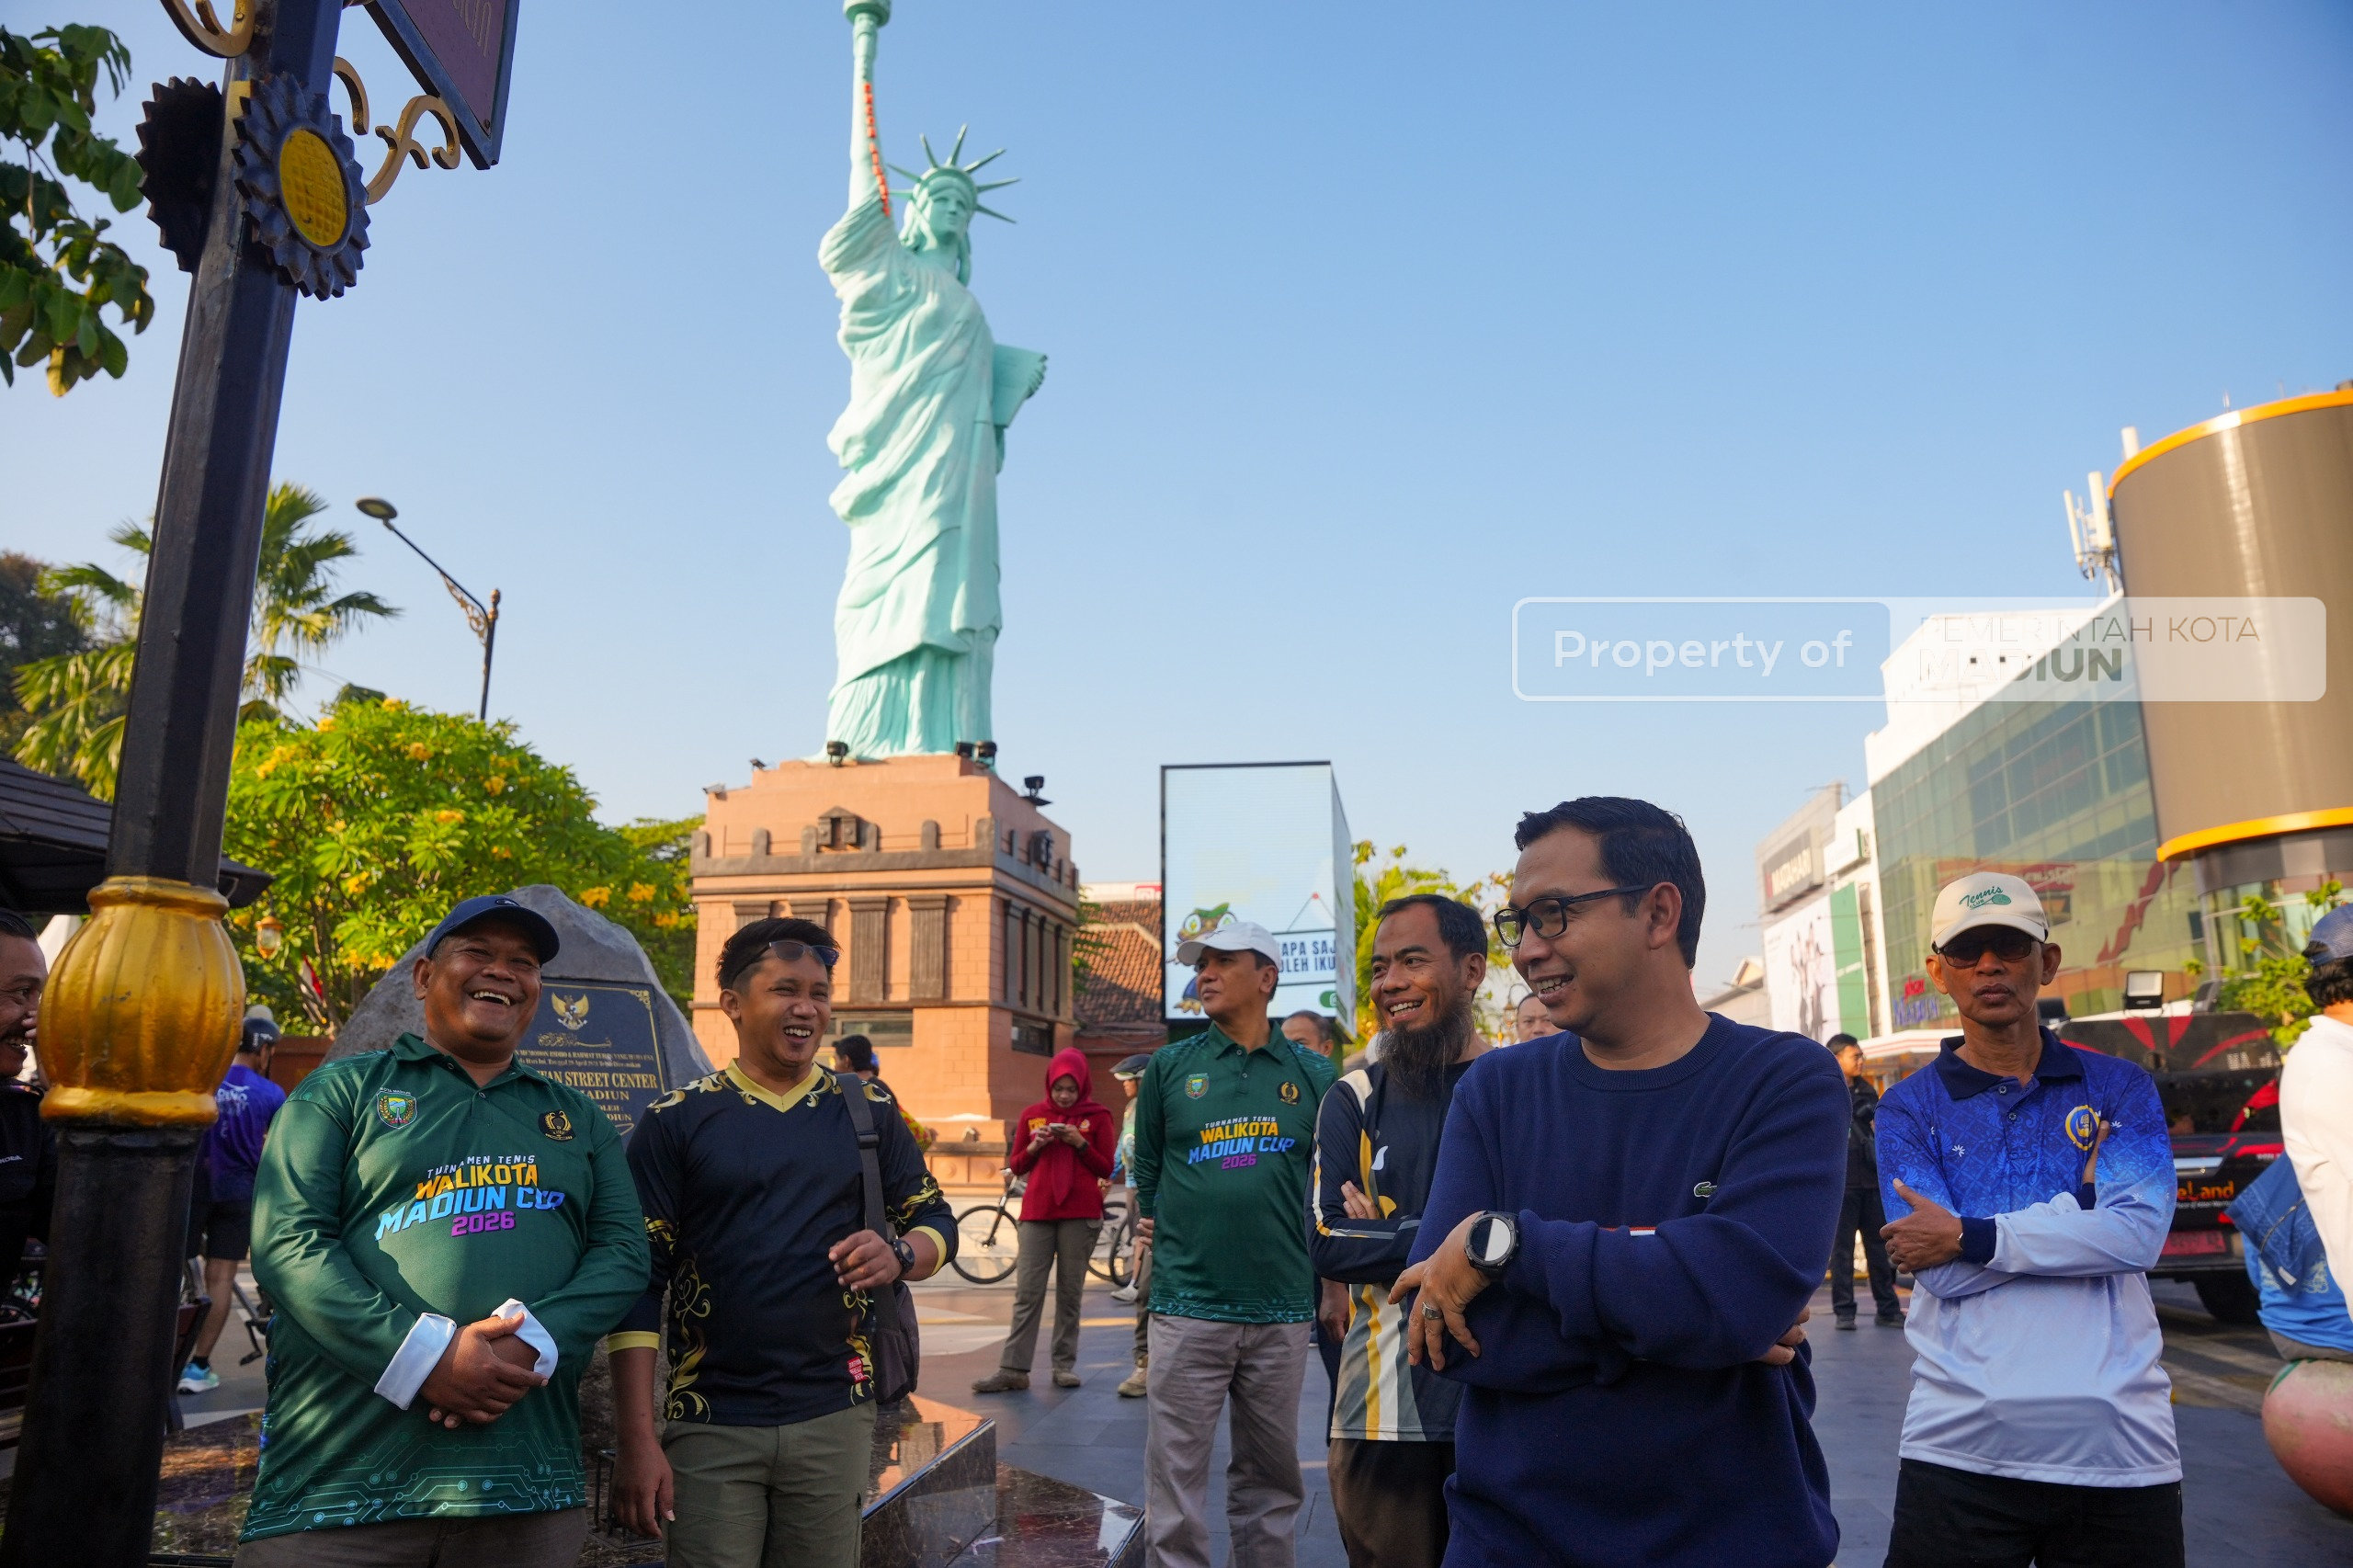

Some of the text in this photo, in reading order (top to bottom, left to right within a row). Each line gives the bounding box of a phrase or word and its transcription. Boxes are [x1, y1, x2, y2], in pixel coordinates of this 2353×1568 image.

[1959, 886, 2004, 907] Tennis
[565, 1072, 609, 1087] STREET
[612, 1073, 658, 1088] CENTER
[581, 1089, 630, 1101] ADIUN
[1199, 1121, 1279, 1144] WALIKOTA
[1205, 1116, 1248, 1130] TURNAMEN
[1188, 1136, 1296, 1165] MADIUN CUP
[1221, 1153, 1257, 1170] 2026
[427, 1154, 536, 1179] TURNAMEN TENIS
[415, 1163, 539, 1200] WALIKOTA
[374, 1186, 565, 1242] MADIUN CUP
[450, 1210, 516, 1238] 2026
